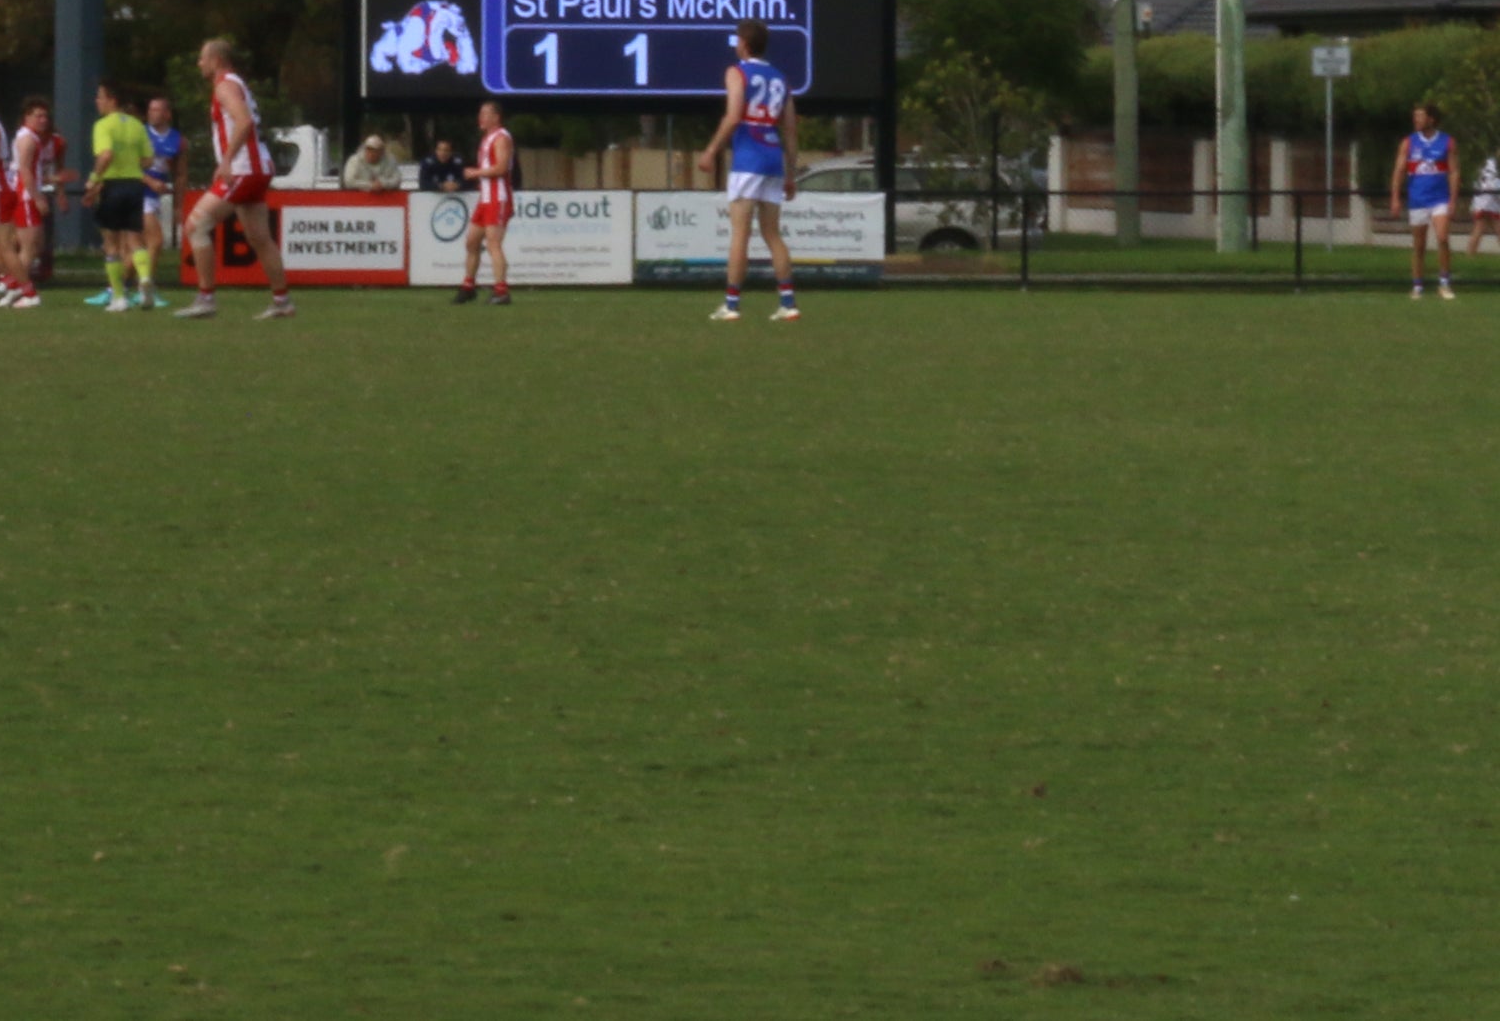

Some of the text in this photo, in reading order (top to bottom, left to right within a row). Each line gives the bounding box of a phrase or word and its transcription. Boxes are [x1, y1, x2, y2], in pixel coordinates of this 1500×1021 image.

[533, 33, 649, 86] 1 1
[747, 74, 786, 118] 28
[565, 195, 612, 218] out
[289, 220, 376, 233] JOHN BARR
[288, 241, 398, 255] INVESTMENTS
